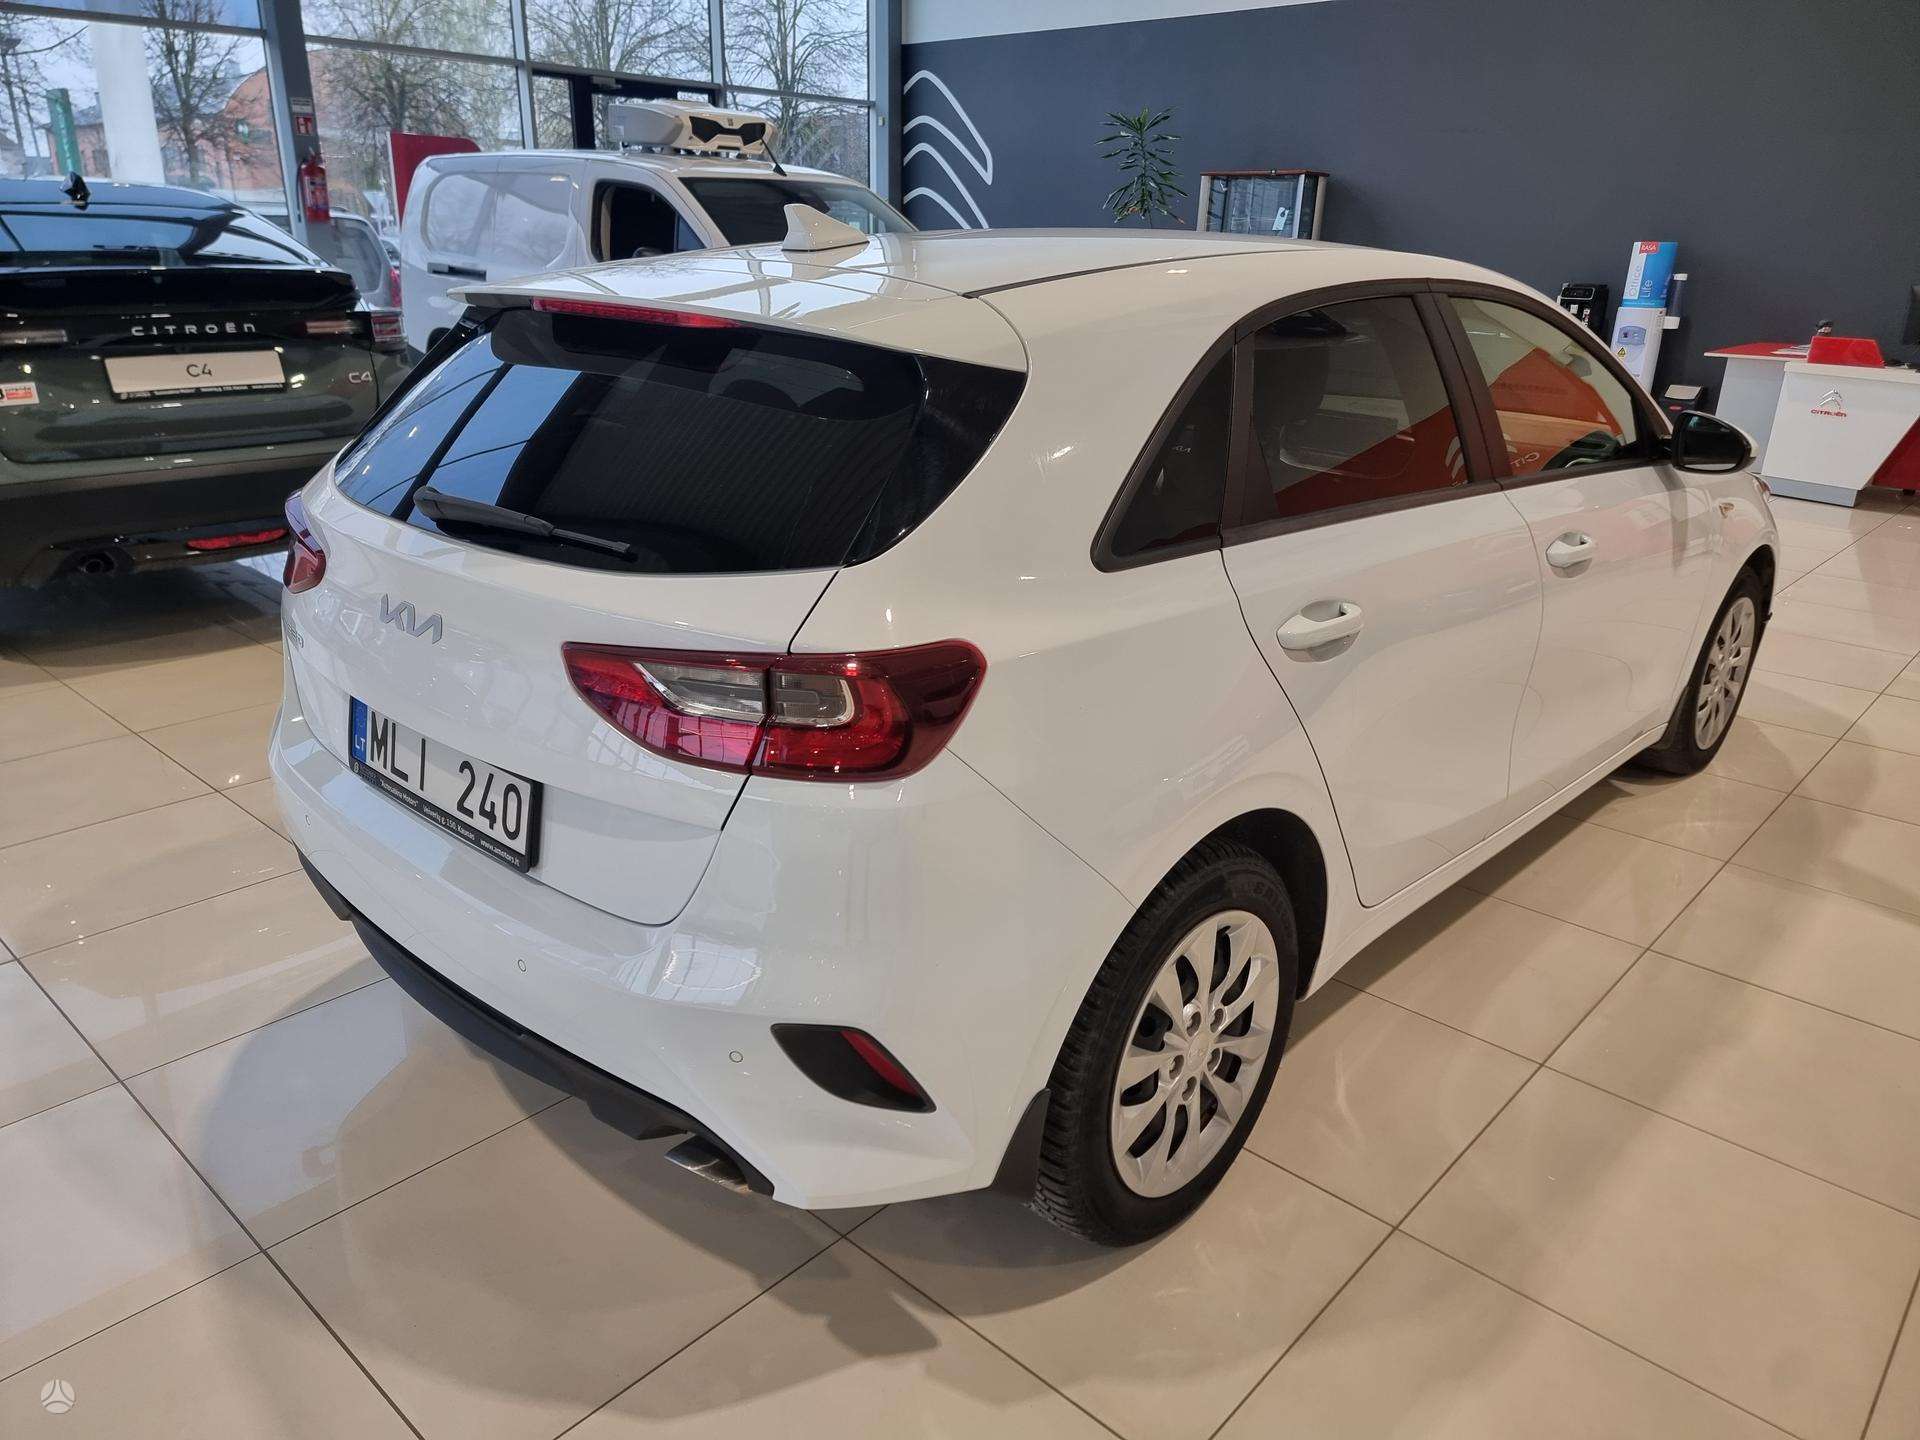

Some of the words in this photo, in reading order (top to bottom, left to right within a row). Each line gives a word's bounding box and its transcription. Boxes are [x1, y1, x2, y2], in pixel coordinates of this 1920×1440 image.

[1640, 279, 1653, 298] Life
[186, 363, 213, 378] C4
[349, 371, 373, 384] C4
[379, 593, 443, 645] KIA
[354, 734, 366, 752] LT
[370, 710, 426, 791] MLI
[457, 760, 522, 841] 240
